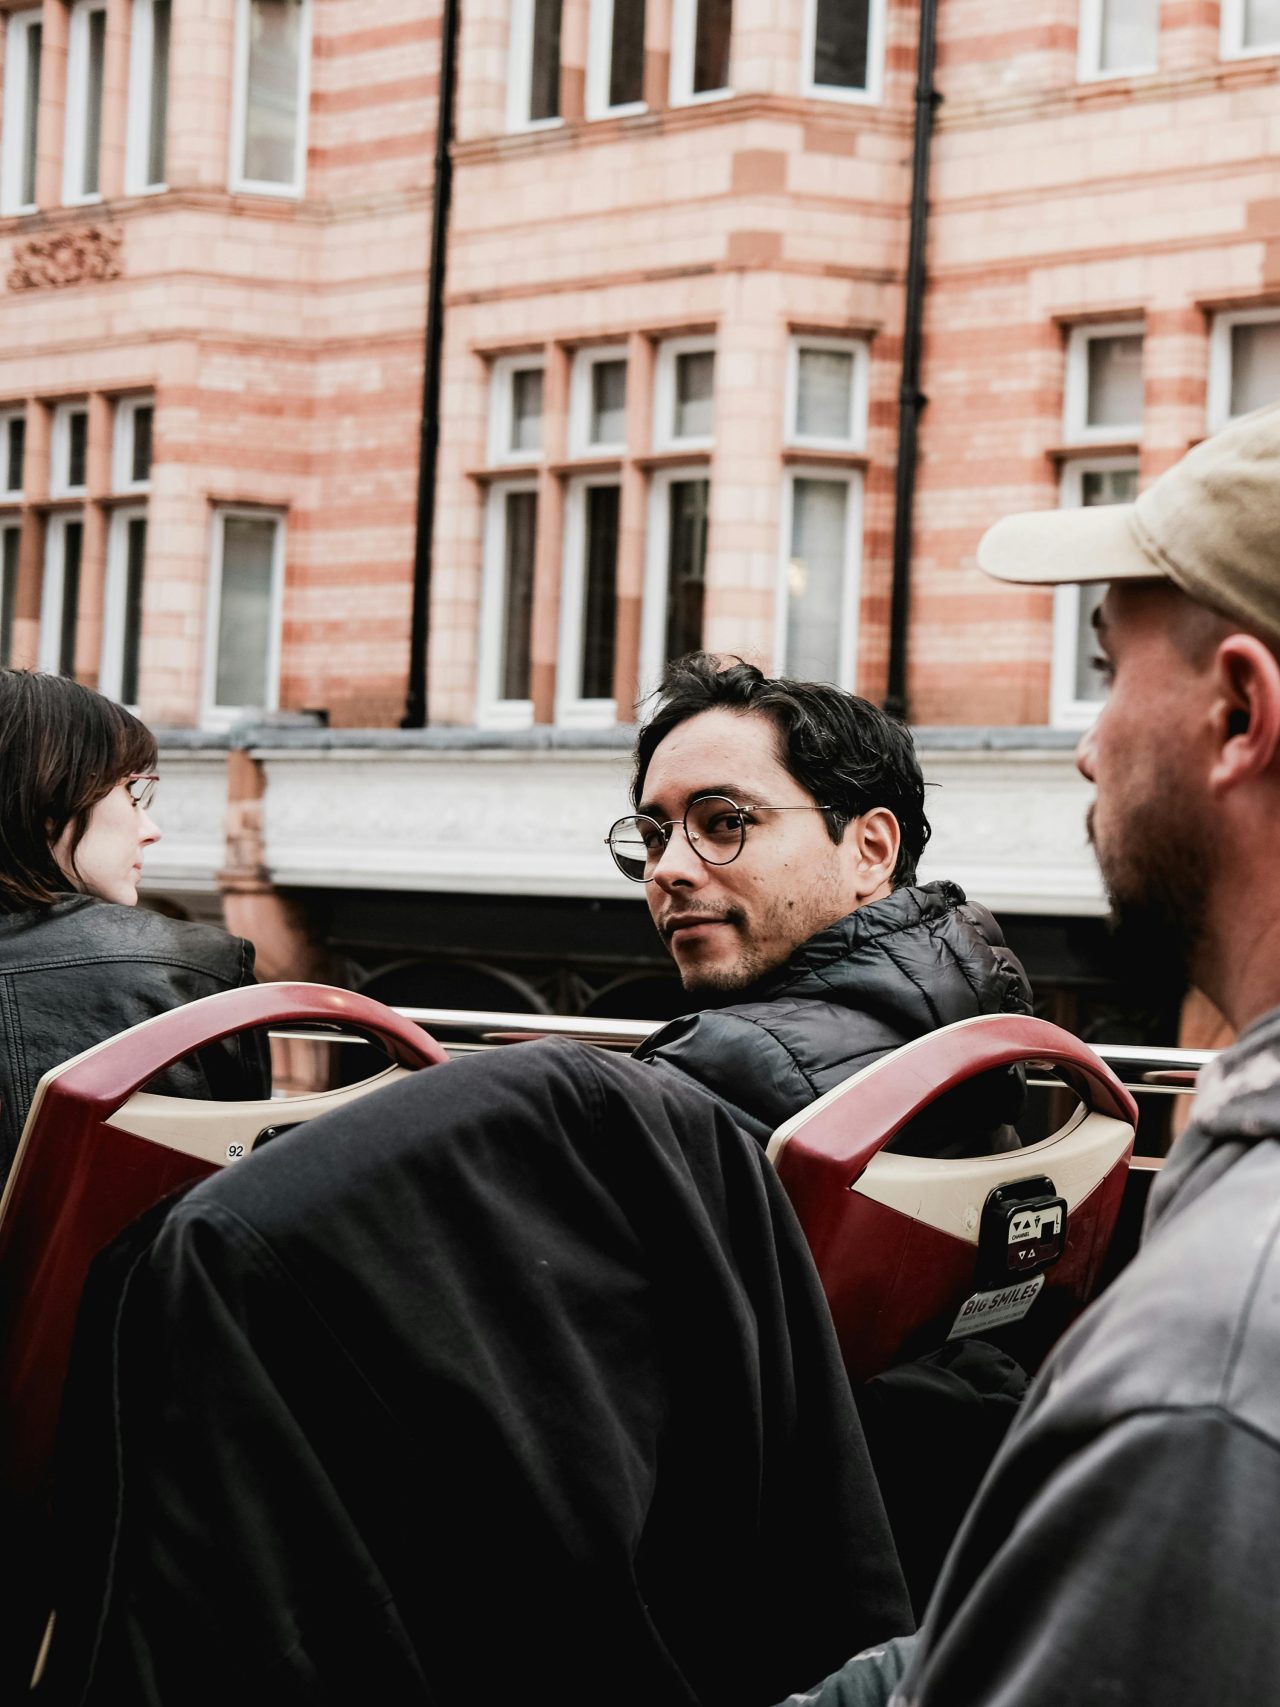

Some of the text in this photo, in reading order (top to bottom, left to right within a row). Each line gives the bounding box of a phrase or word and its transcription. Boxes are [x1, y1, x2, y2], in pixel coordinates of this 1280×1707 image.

[228, 1145, 243, 1157] 92
[1011, 1231, 1030, 1241] CHANNEL
[962, 1299, 987, 1316] BIG
[988, 1282, 1039, 1309] SMILES
